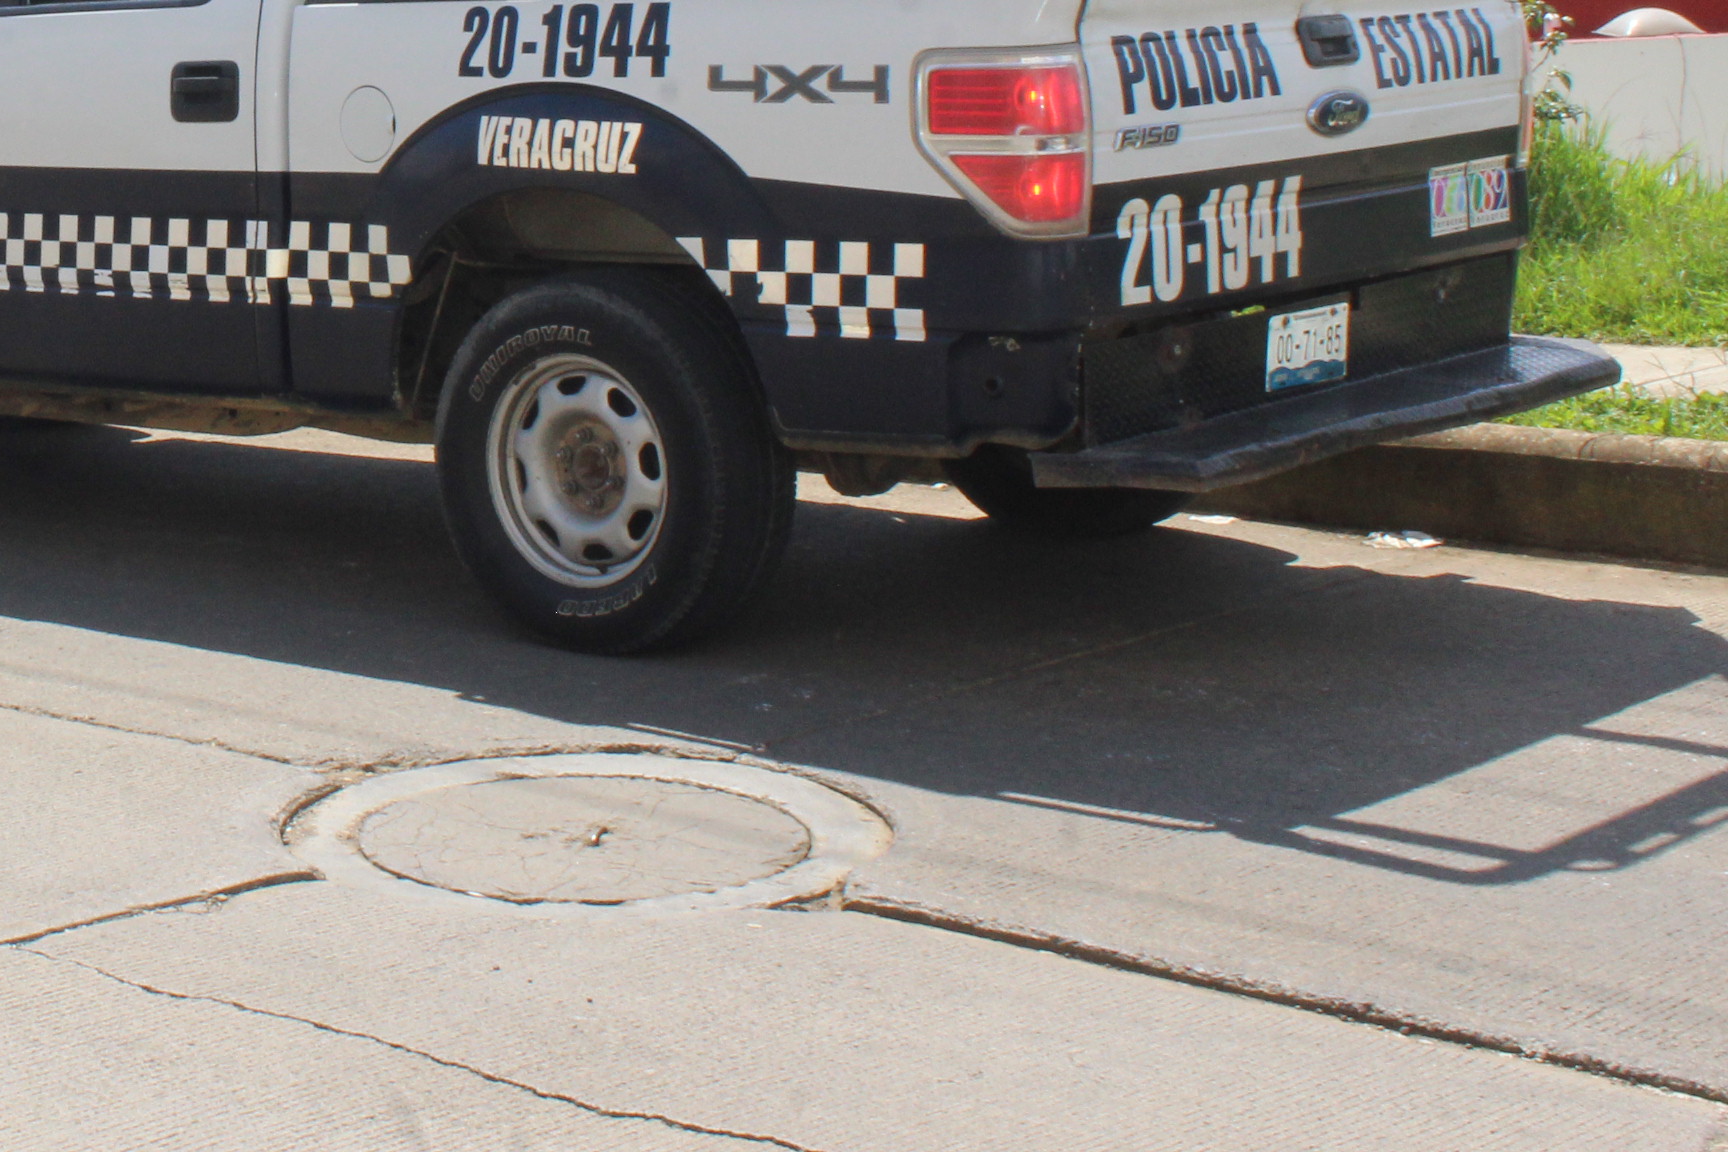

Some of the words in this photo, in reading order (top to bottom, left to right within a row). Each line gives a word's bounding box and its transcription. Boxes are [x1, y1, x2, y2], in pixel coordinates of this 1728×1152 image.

[458, 2, 671, 79] 20-1944
[1111, 22, 1282, 115] POLICIA
[1359, 8, 1500, 89] ESTATAL
[477, 116, 642, 174] VERACRUZ
[1117, 175, 1302, 306] 20-1944
[469, 325, 593, 400] UNIROYAL
[1276, 324, 1342, 364] 00-71-85
